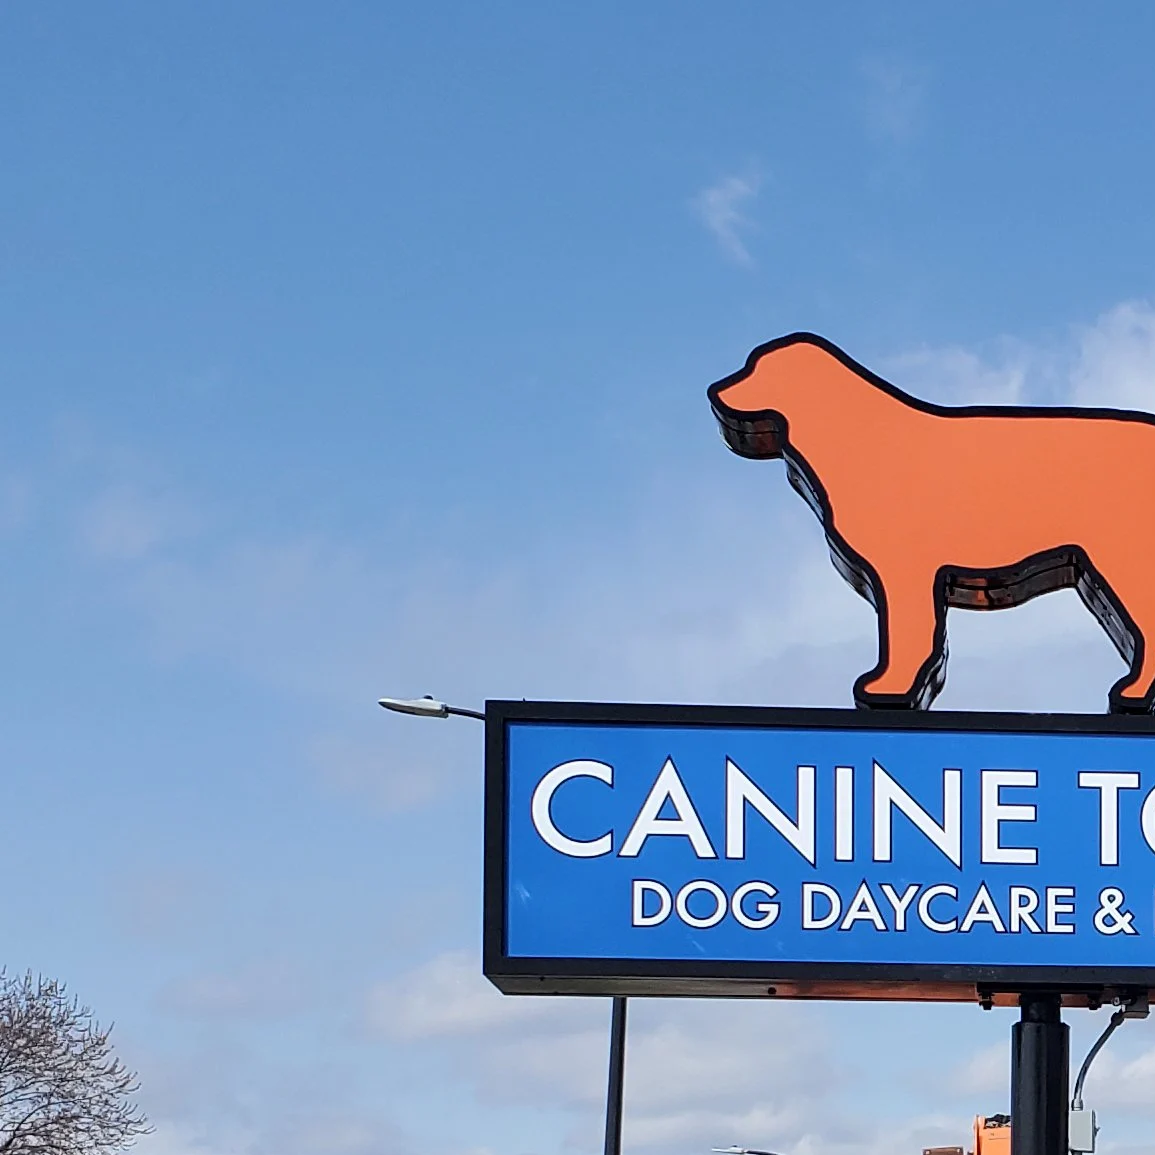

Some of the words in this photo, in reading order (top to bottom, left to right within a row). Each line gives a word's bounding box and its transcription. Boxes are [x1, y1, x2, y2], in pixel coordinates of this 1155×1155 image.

[531, 754, 1038, 870] CANINE
[632, 878, 781, 930] DOG
[802, 879, 1075, 934] DAYCARE
[1093, 886, 1138, 935] &
